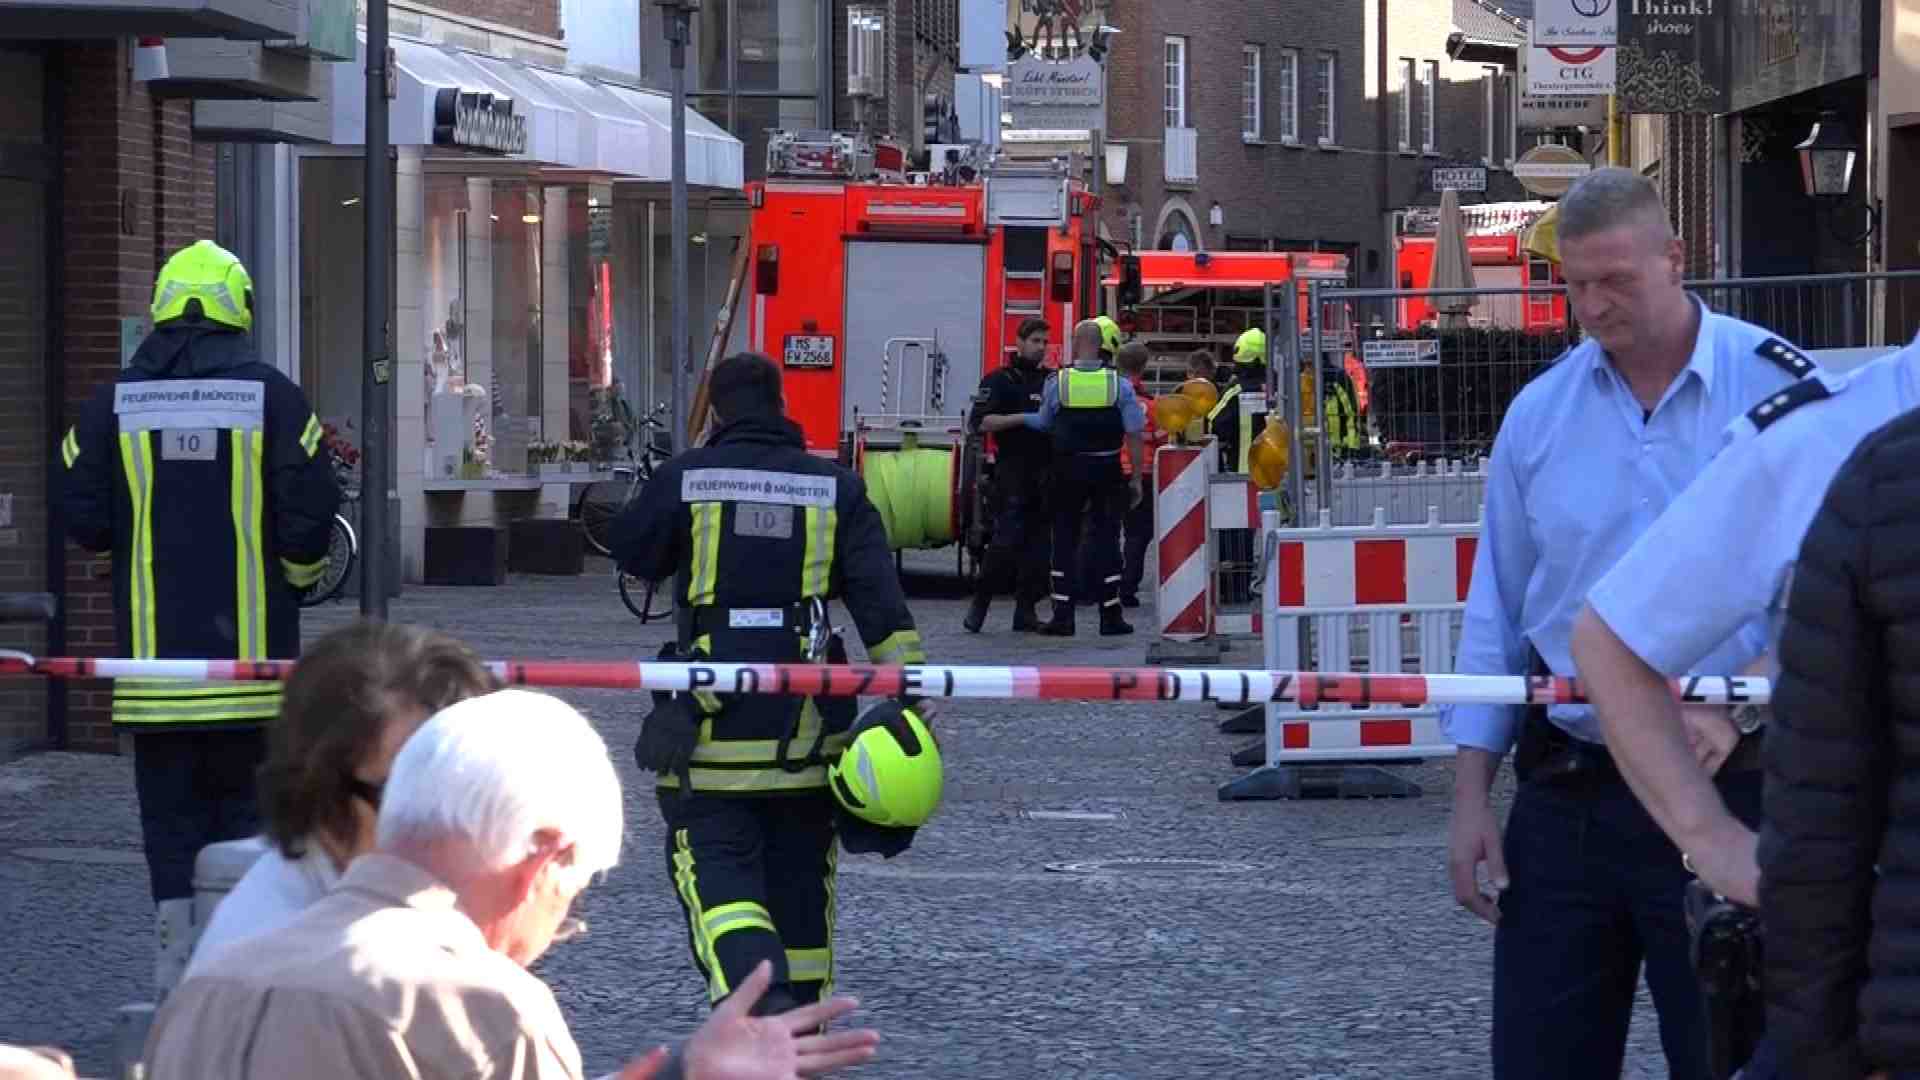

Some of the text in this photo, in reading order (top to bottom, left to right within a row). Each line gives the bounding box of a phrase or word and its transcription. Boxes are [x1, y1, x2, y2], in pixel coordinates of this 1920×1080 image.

[1631, 0, 1713, 15] Think!
[1646, 18, 1694, 35] shoes
[1559, 66, 1593, 80] CTG
[1435, 170, 1485, 181] HOTEL
[786, 351, 801, 362] FW
[121, 389, 256, 404] FEUERWEHR MÜNSTER
[176, 434, 201, 453] 10
[688, 480, 830, 498] FEUERWEHR MÜNSTER
[752, 510, 777, 530] 10
[687, 666, 954, 698] POLIZEI
[1112, 670, 1371, 703] POLIZEI
